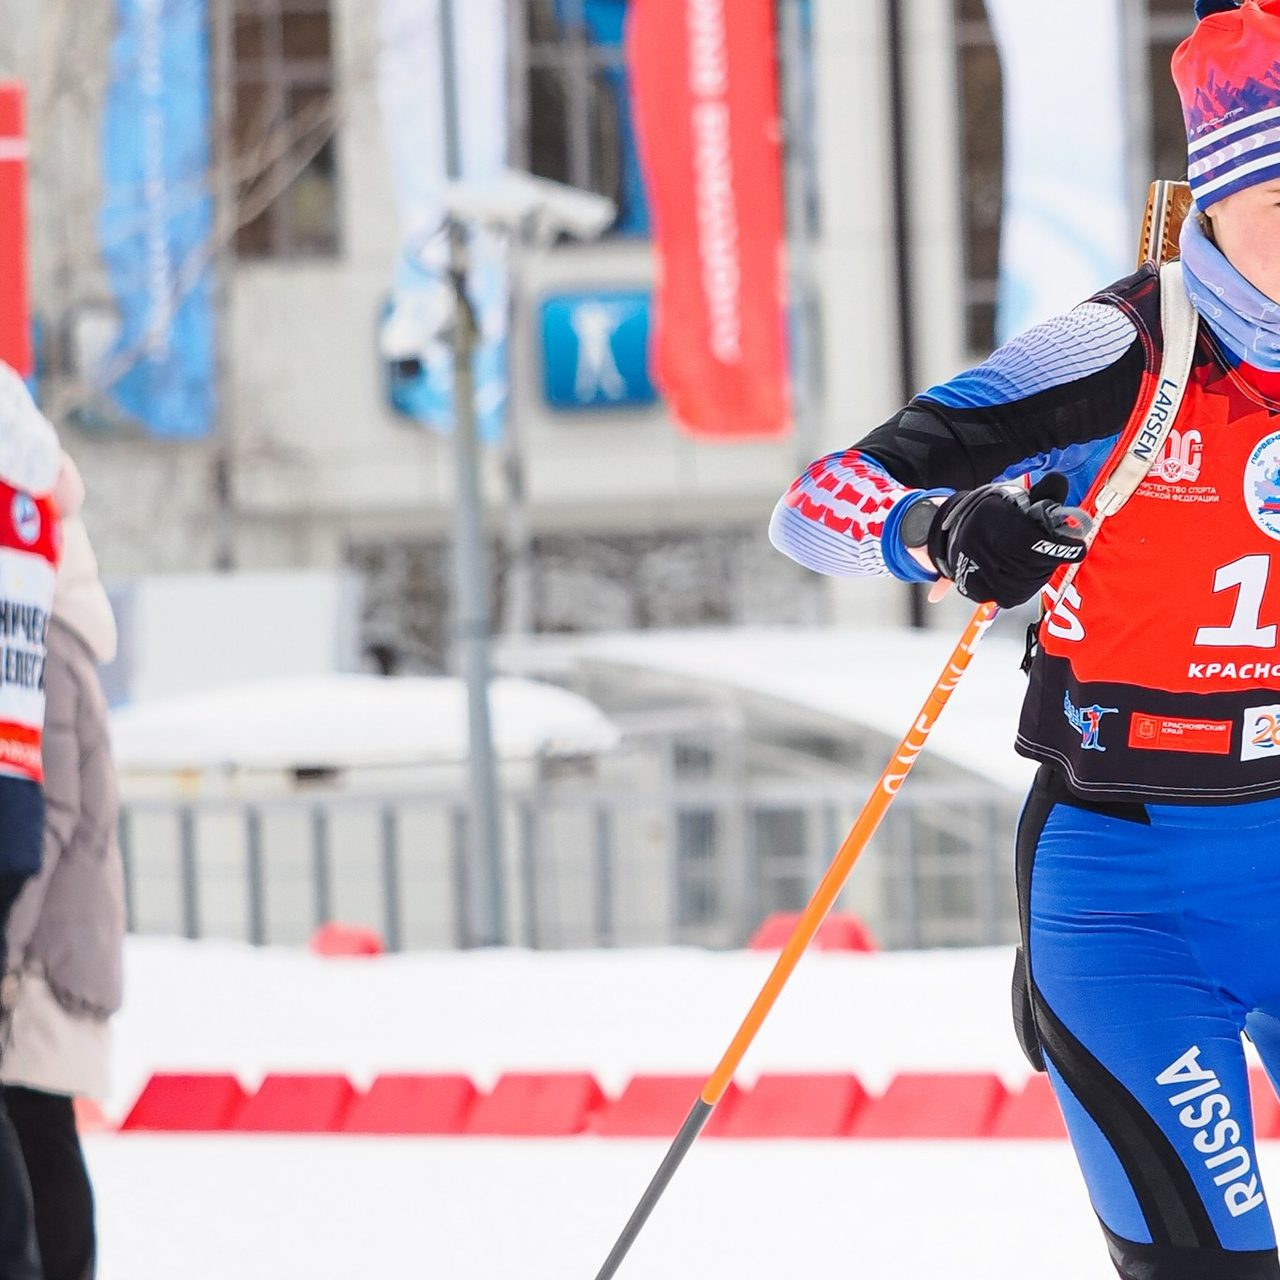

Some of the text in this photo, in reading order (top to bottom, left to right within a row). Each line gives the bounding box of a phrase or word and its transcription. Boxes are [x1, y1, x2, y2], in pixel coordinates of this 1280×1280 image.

[1133, 378, 1178, 461] LARSEN
[1187, 486, 1216, 494] СПОРТА
[1155, 1045, 1264, 1217] RUSSIA
